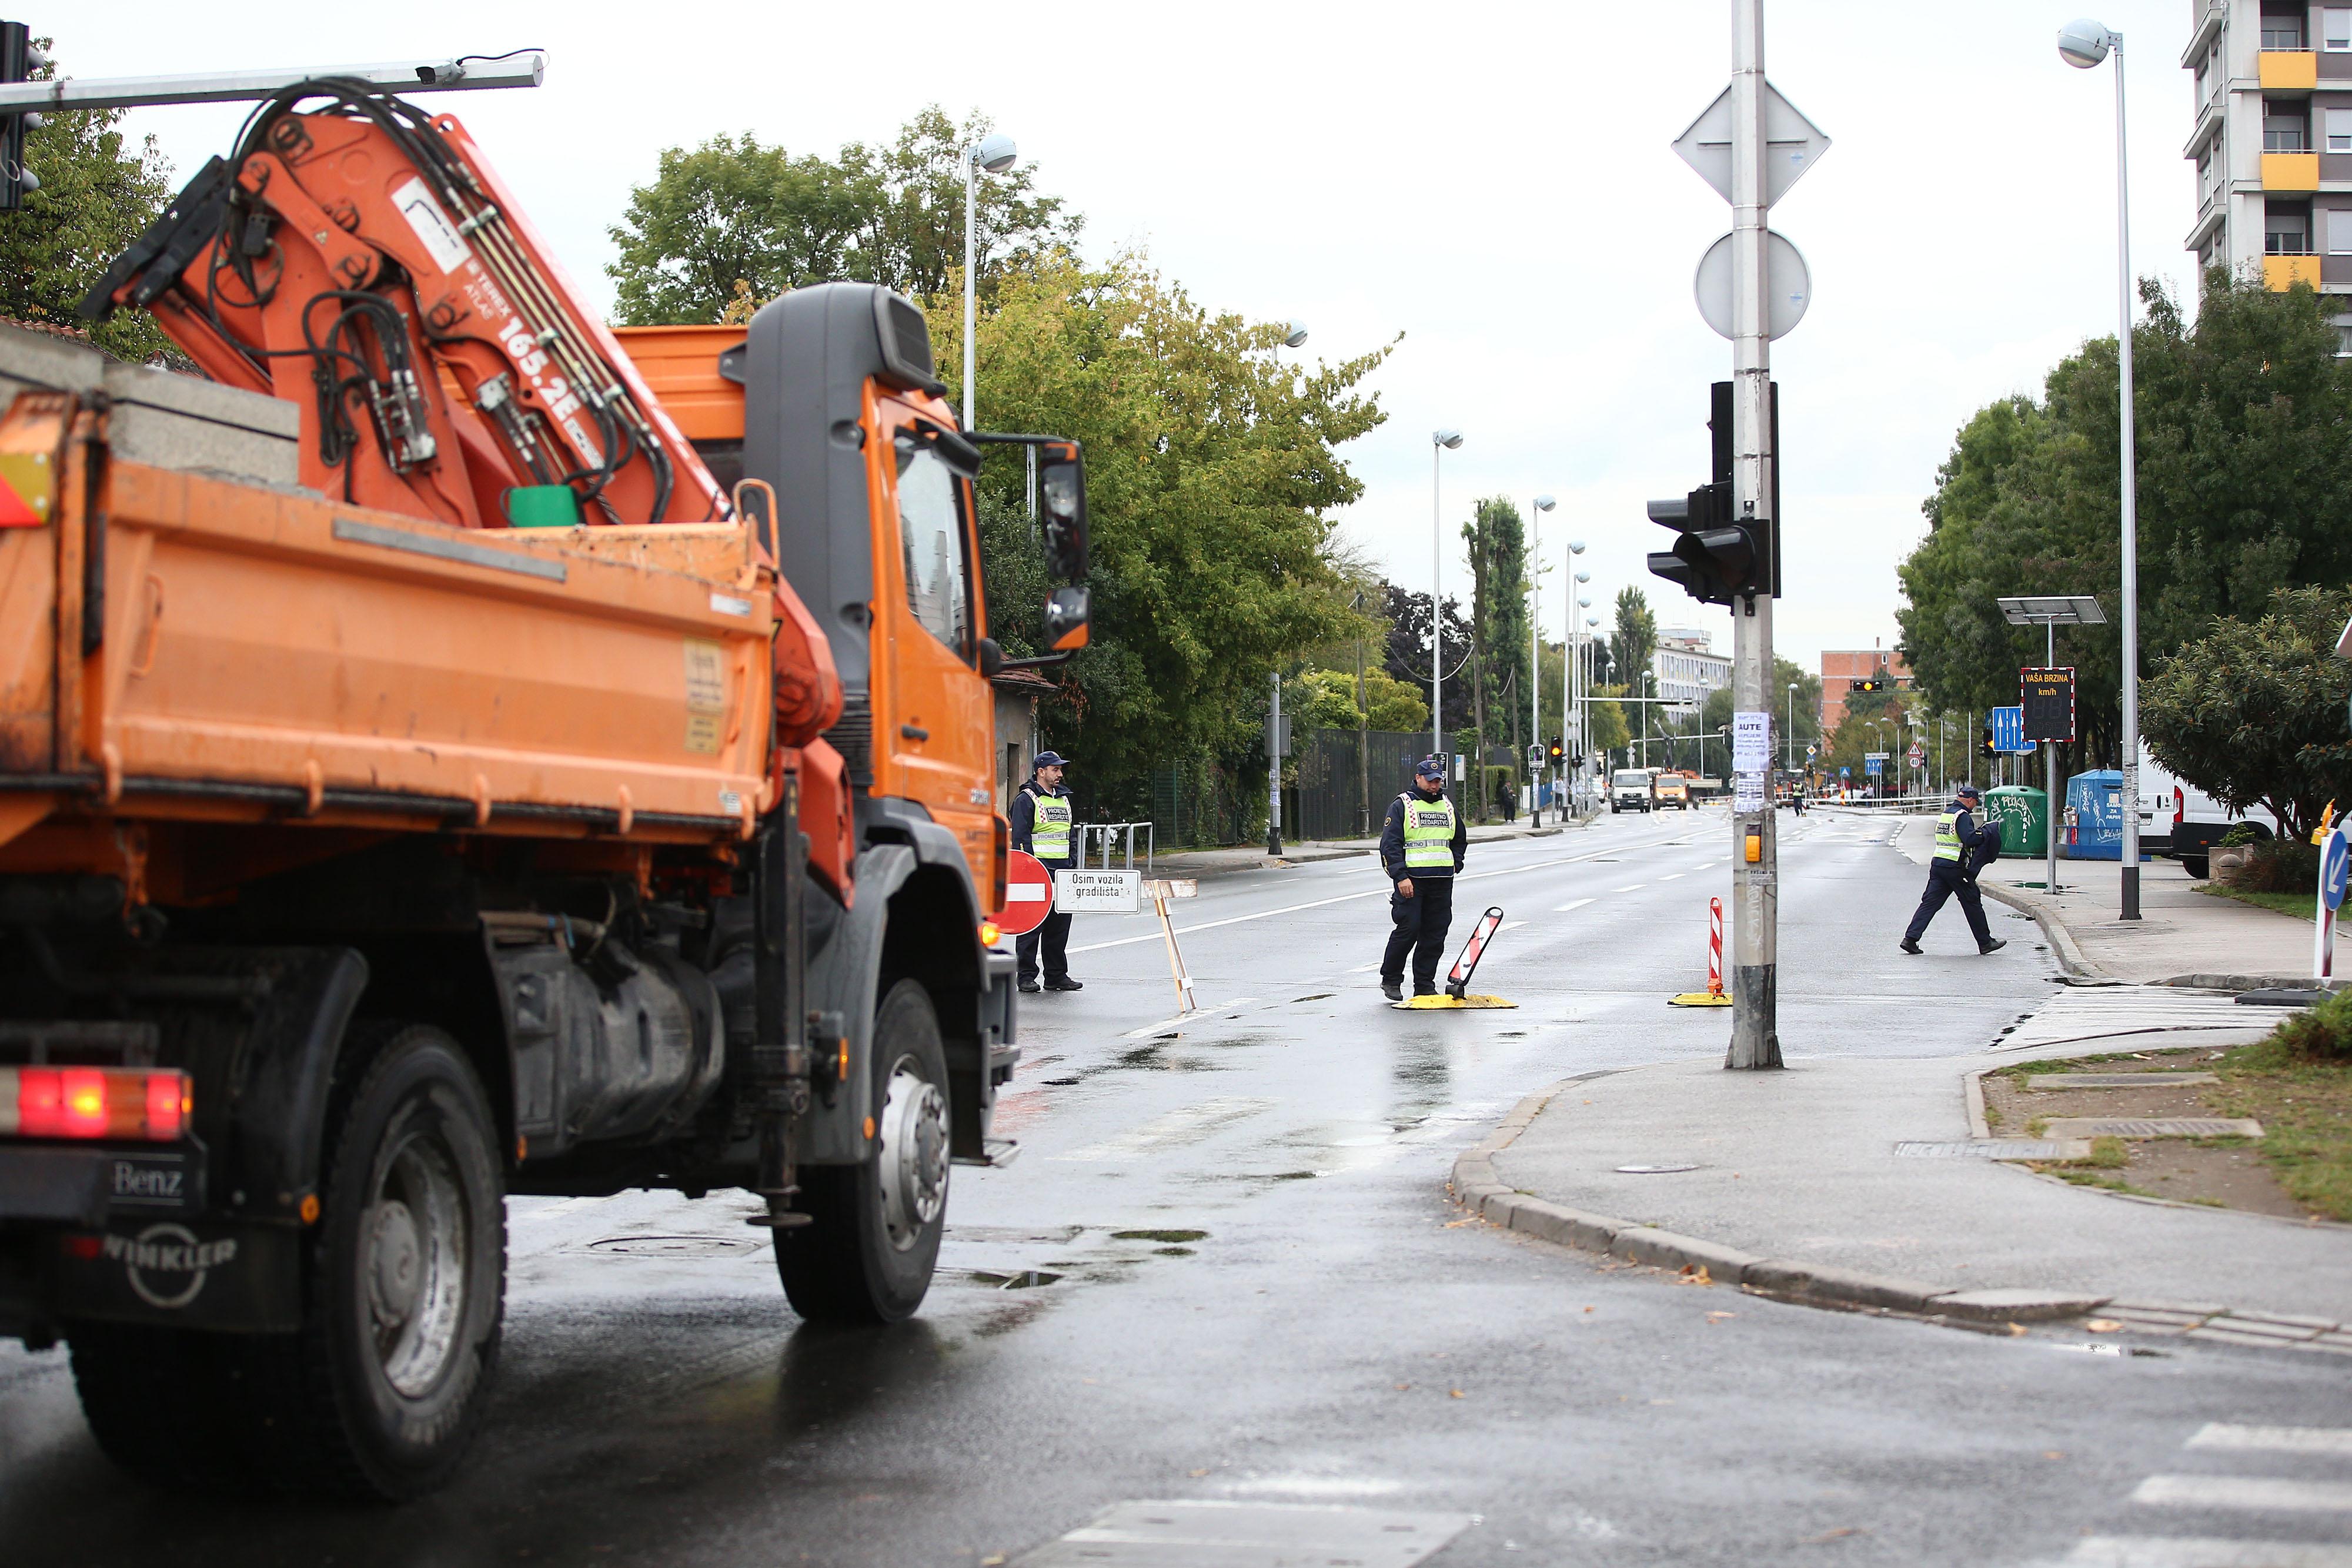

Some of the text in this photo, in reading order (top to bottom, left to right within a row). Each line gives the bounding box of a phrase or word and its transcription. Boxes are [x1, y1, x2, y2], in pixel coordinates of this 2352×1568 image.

[463, 284, 495, 320] ATLAS
[477, 272, 513, 317] TEREX
[498, 316, 583, 421] 165.2E
[2025, 673, 2069, 683] VAŠA BRZINA
[2038, 688, 2056, 696] km/h
[1072, 873, 1123, 884] Osim vozila
[1076, 886, 1119, 899] gradilišta
[114, 1161, 183, 1196] Benz
